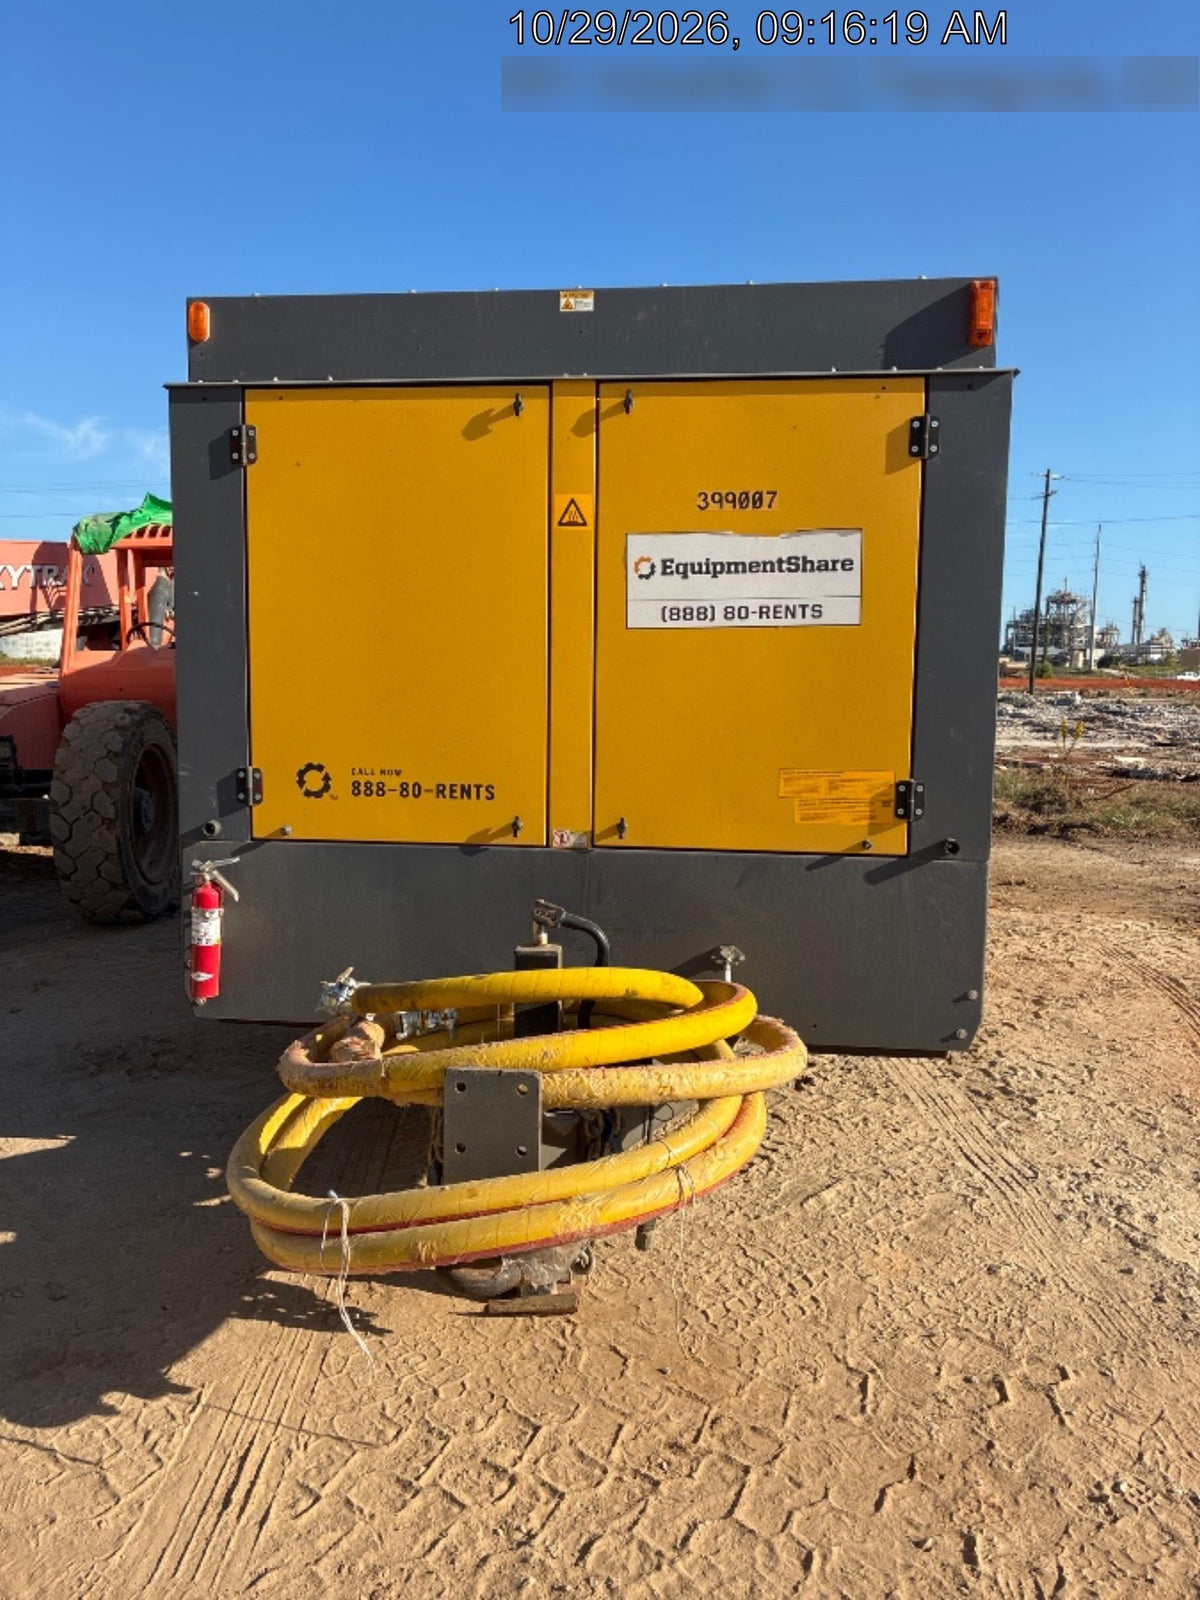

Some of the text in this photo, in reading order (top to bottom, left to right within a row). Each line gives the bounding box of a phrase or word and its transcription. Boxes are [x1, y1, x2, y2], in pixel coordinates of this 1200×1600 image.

[697, 490, 778, 511] 399007
[660, 556, 854, 579] EquipmentShare
[661, 604, 823, 622] (888) 80-RENTS
[351, 767, 402, 777] CALL NOW
[351, 780, 495, 801] 888-80-RENTS
